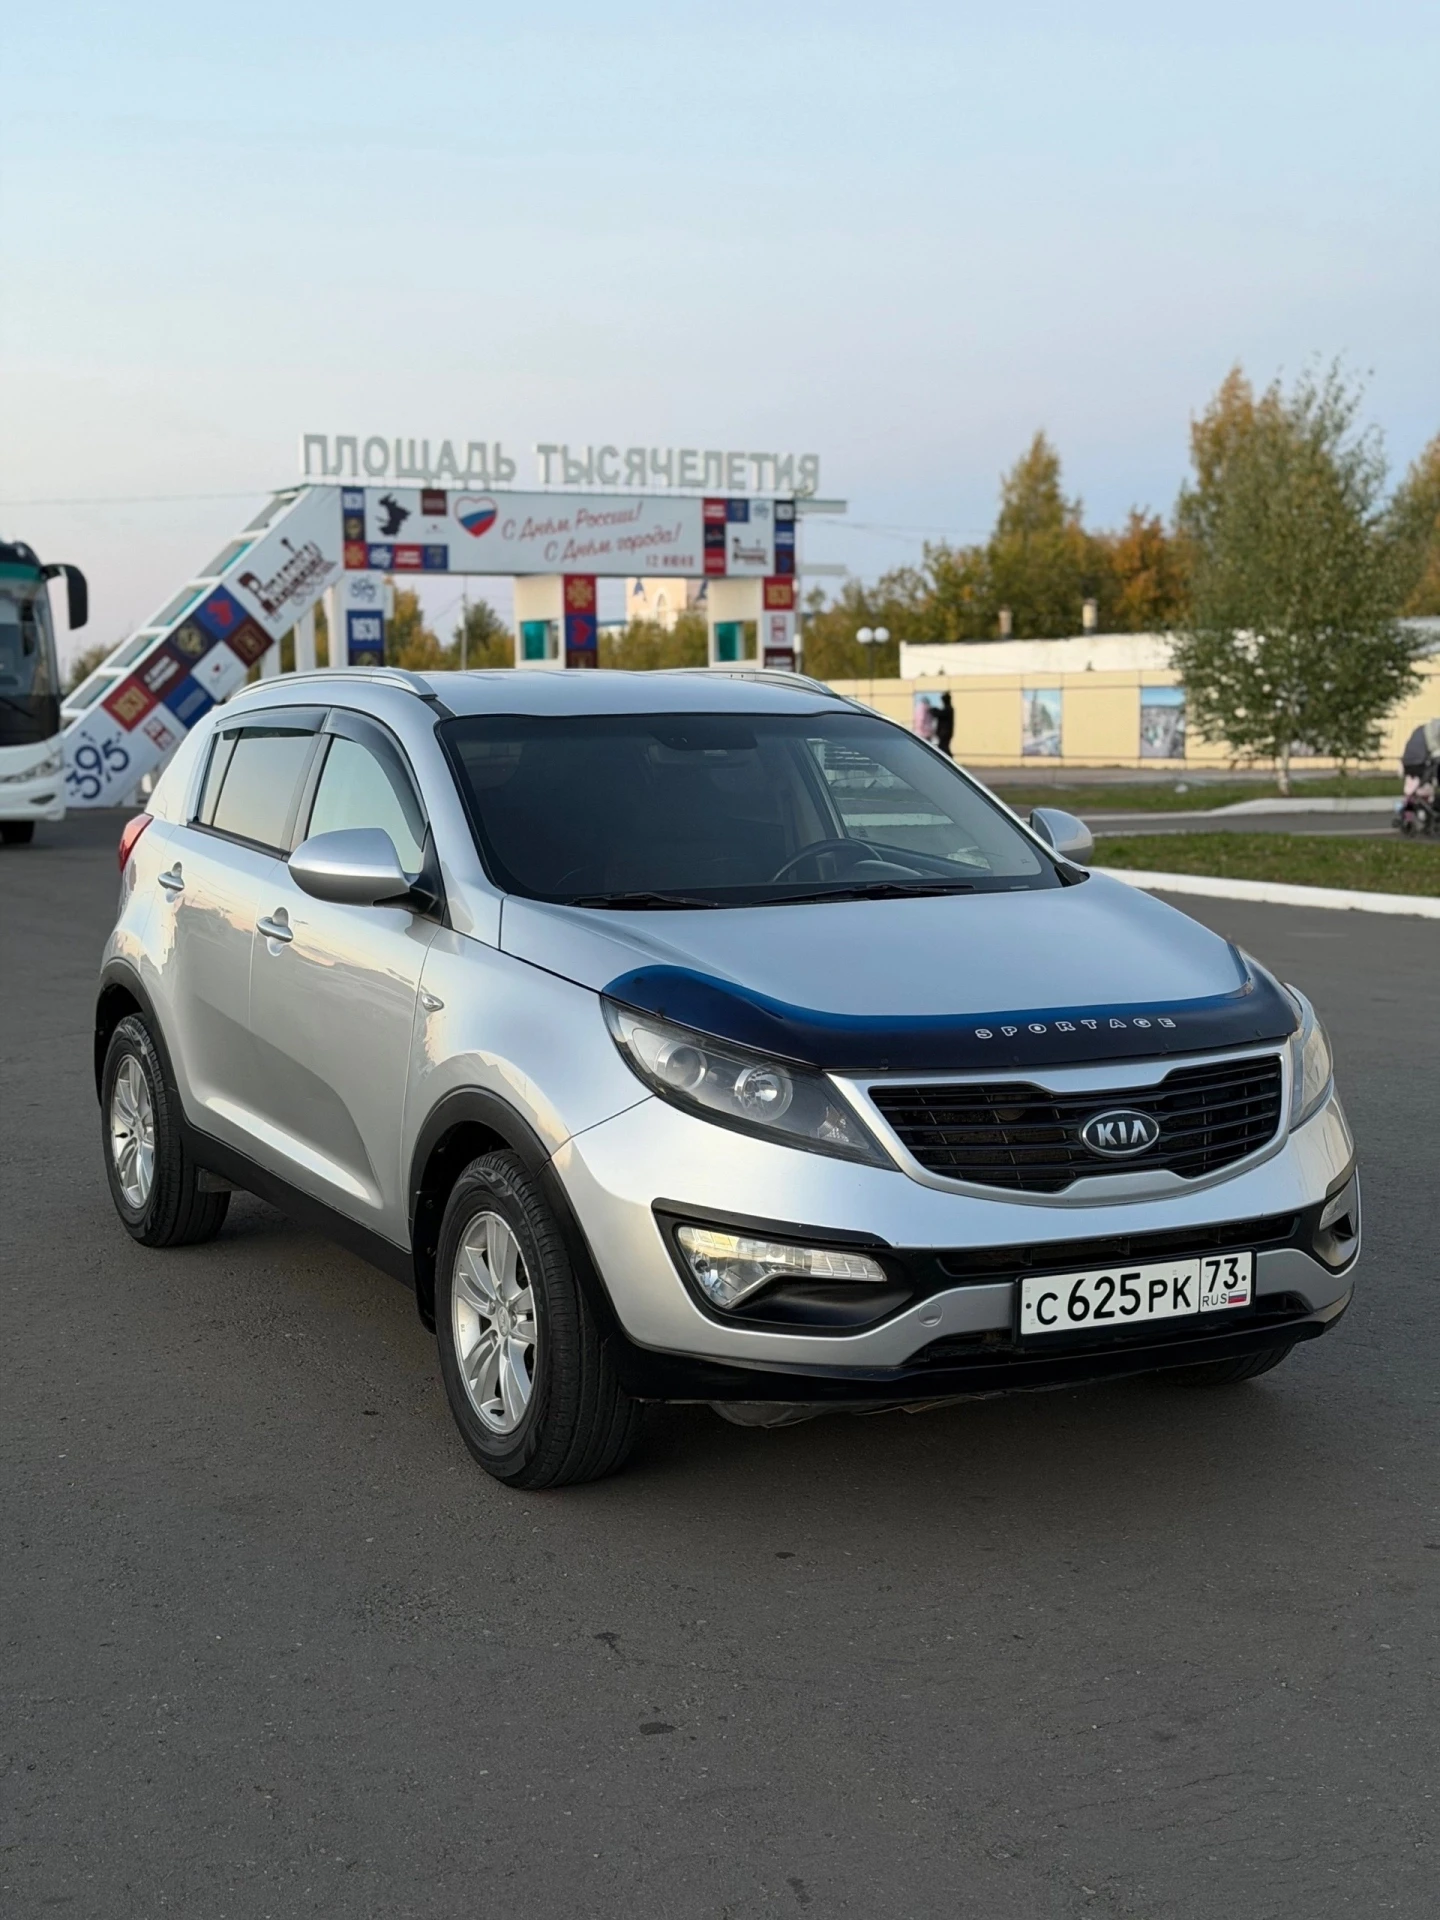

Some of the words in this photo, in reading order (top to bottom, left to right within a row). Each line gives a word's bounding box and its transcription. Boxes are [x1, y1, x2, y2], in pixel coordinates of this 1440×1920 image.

[303, 433, 517, 488] ПЛОЩАДЬ
[536, 443, 819, 491] ТЫСЯЧЕЛЕТИЯ
[502, 518, 516, 540] С
[575, 501, 643, 531] России!
[543, 541, 558, 562] С
[975, 1018, 1176, 1039] SPORTAGE
[1096, 1120, 1149, 1146] KIA
[1205, 1258, 1239, 1293] 73
[1202, 1293, 1227, 1307] RUS
